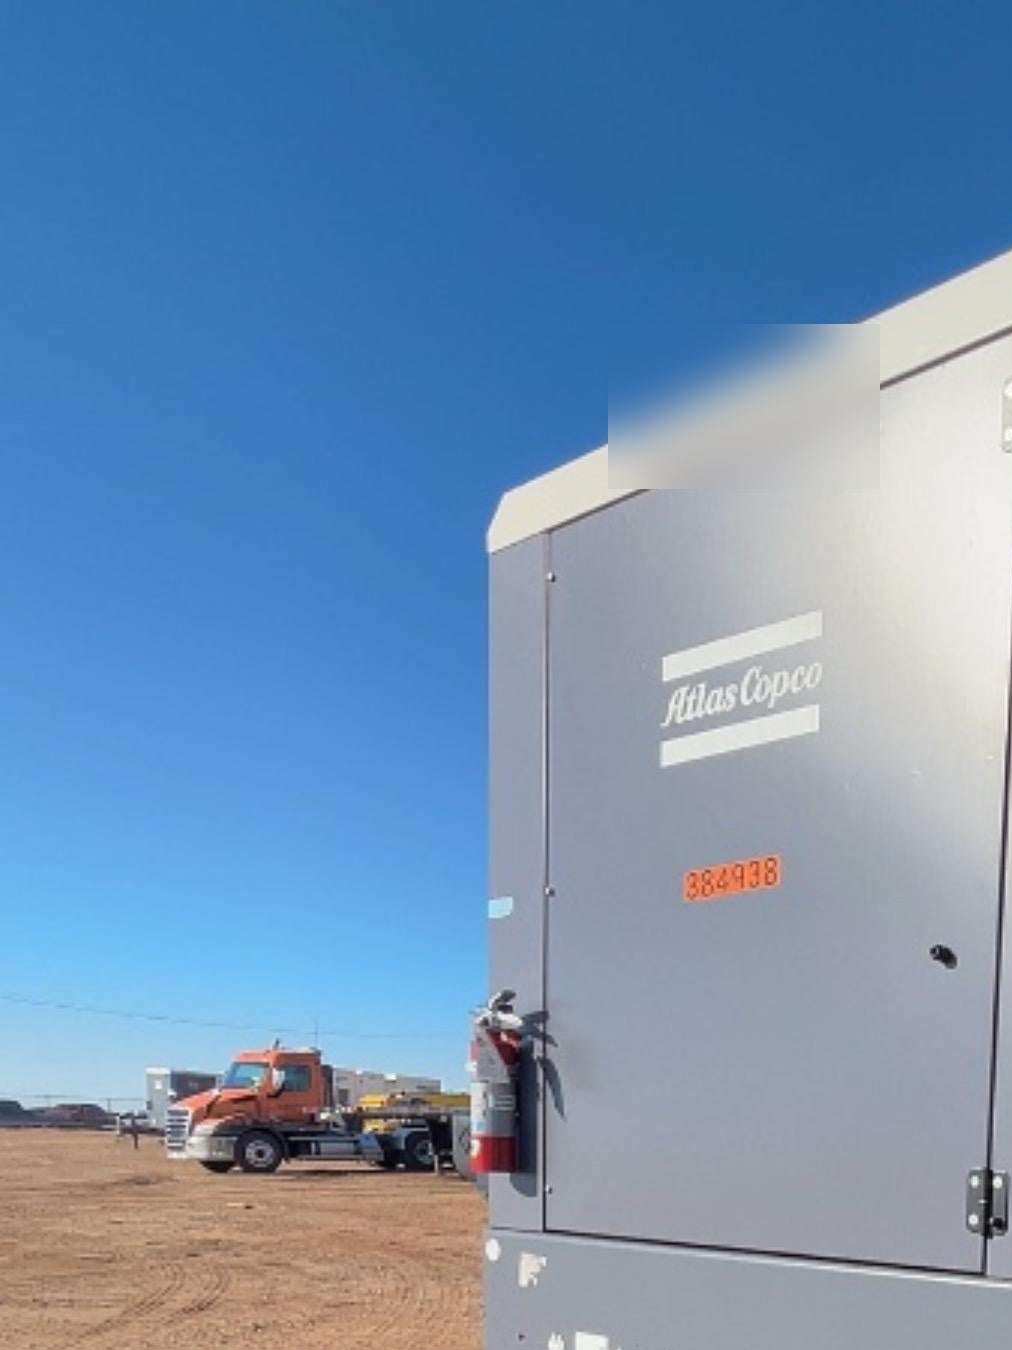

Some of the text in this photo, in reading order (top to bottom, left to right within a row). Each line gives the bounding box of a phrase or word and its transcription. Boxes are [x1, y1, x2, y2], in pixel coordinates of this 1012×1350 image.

[660, 662, 823, 728] Atlas Copco
[685, 856, 779, 900] 384938
